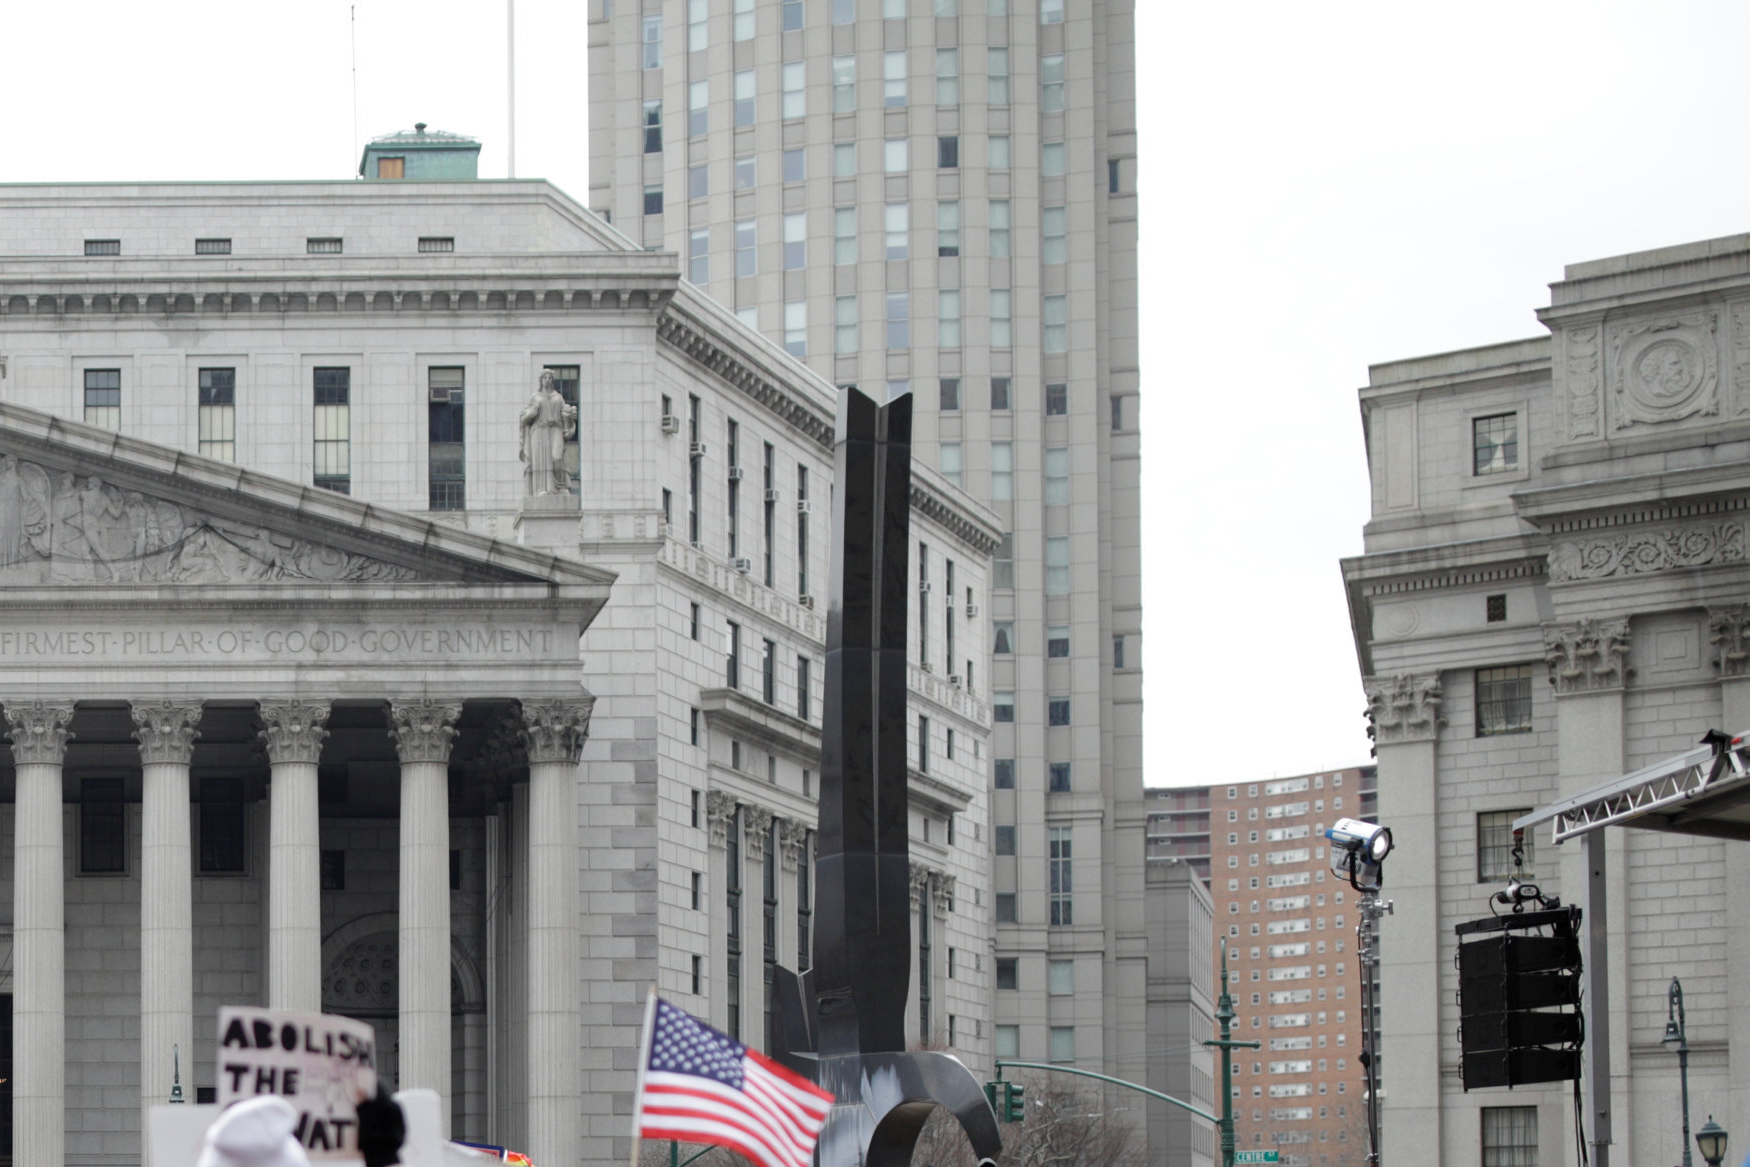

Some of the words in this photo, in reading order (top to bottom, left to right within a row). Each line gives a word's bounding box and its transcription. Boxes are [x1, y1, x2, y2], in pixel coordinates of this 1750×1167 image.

[0, 631, 112, 656] FIRMEST
[122, 631, 210, 655] PILLAR
[216, 630, 252, 655] OF
[263, 630, 348, 654] GOOD
[359, 630, 553, 654] GOVERNMENT
[223, 1018, 374, 1067] ABOLISH
[225, 1063, 299, 1095] THE
[1237, 1152, 1265, 1162] CENTRE
